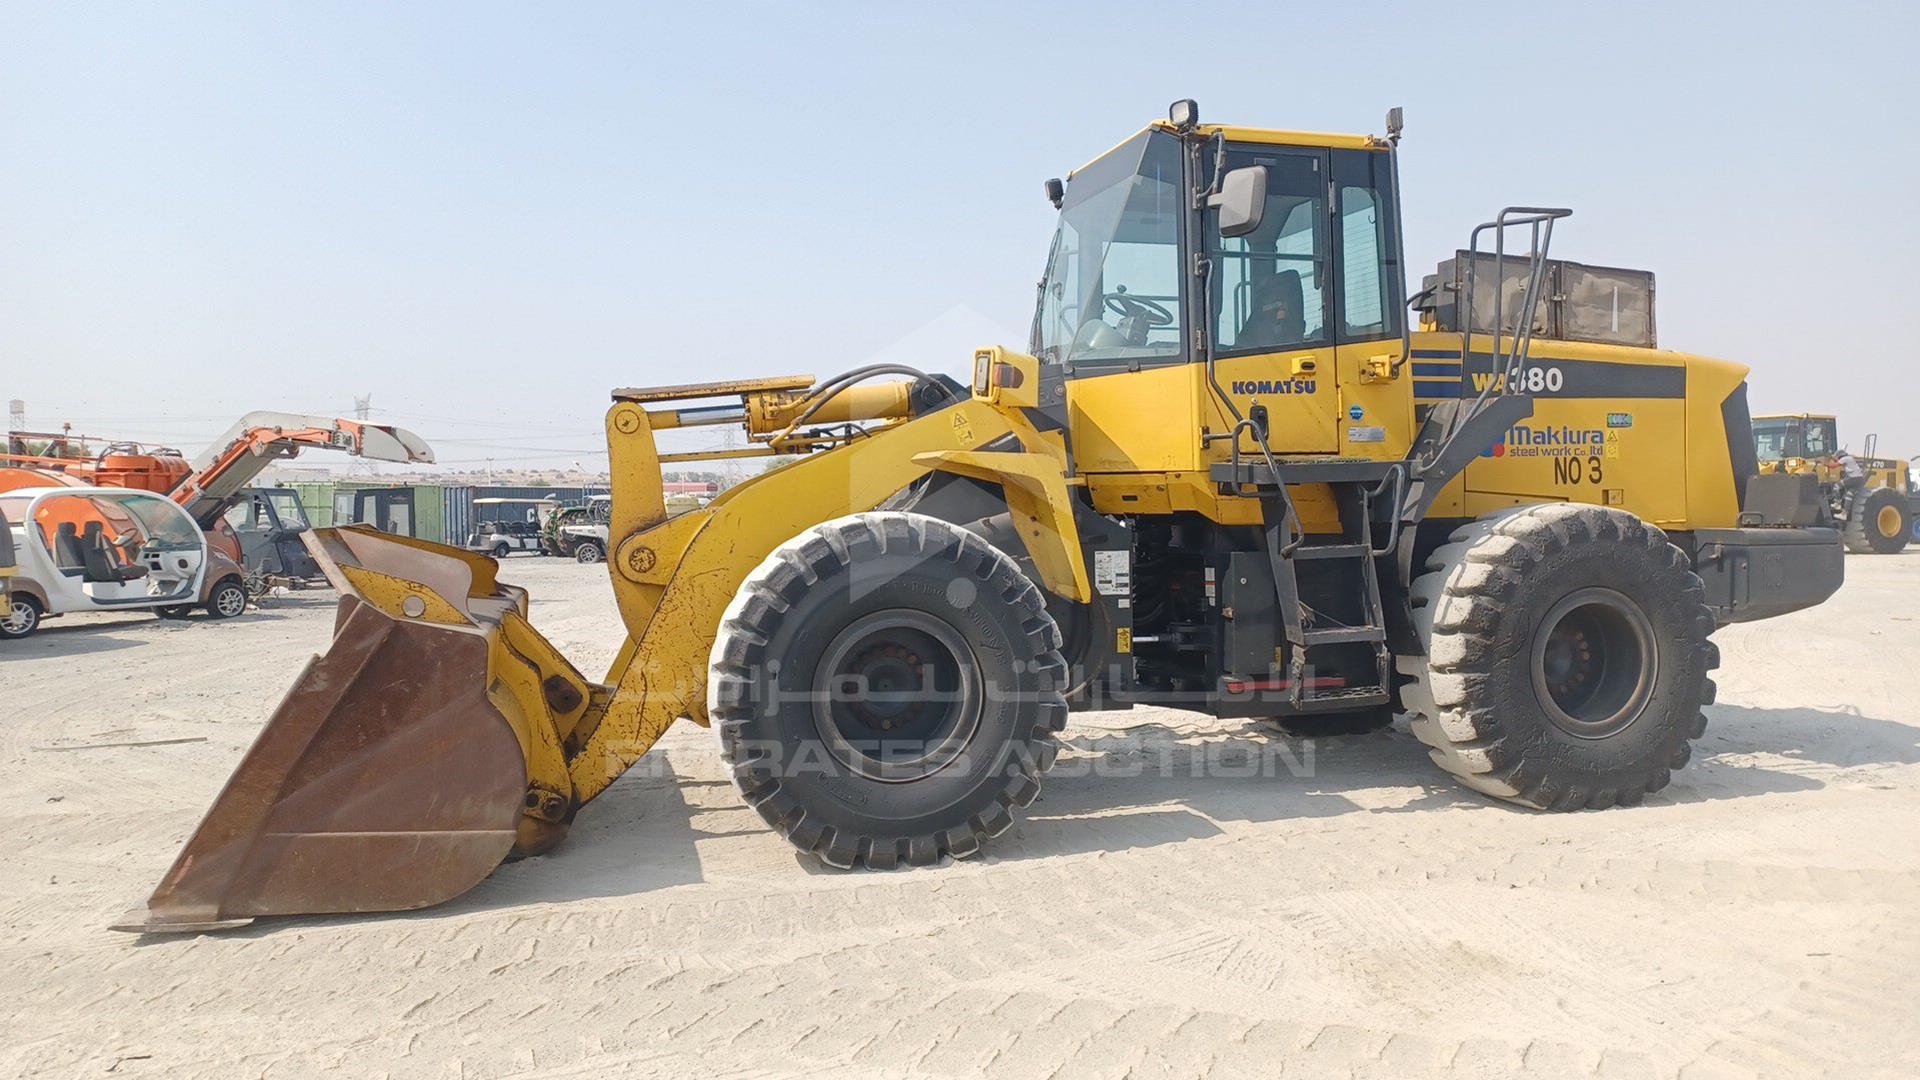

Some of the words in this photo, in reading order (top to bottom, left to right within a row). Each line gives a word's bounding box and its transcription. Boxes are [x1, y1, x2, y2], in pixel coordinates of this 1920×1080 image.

[1232, 377, 1316, 394] KOMATSU
[1509, 426, 1604, 445] Makiura
[1510, 446, 1538, 456] steel
[1541, 446, 1571, 456] work
[1554, 456, 1581, 485] NO
[1588, 456, 1603, 484] 3
